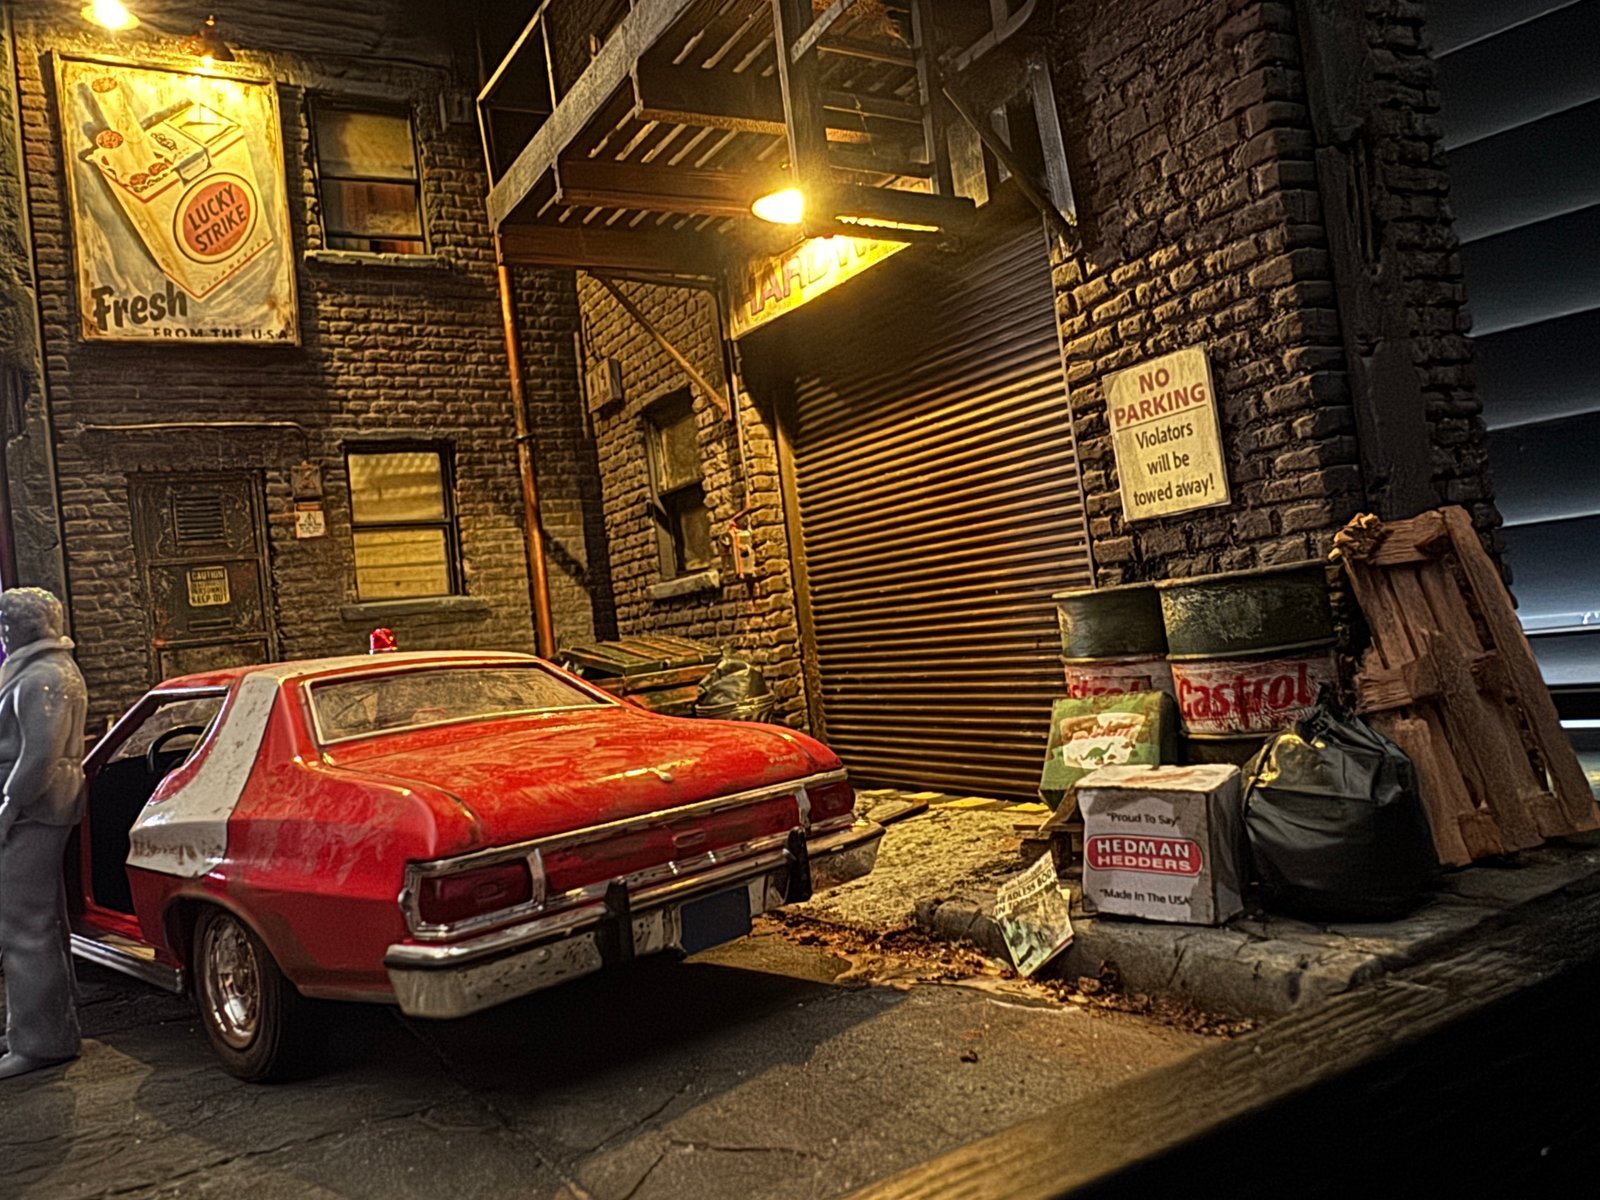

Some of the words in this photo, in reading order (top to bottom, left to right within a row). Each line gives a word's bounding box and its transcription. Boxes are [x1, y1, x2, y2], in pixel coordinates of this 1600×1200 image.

[188, 183, 237, 231] LUCKY
[194, 204, 247, 252] STRIKE
[91, 280, 187, 331] Fresh
[153, 327, 203, 338] FROM
[210, 328, 242, 339] THE
[1138, 368, 1170, 394] NO
[1114, 382, 1206, 427] PARKING
[1135, 422, 1194, 449] Violators
[1146, 453, 1172, 475] will
[1172, 451, 1190, 469] be
[1133, 482, 1173, 506] towed
[1176, 473, 1215, 497] away!
[191, 570, 224, 580] CAUTION
[1179, 663, 1313, 726] Castrol
[1144, 813, 1156, 823] To
[1096, 839, 1190, 858] HEDMAN
[1097, 855, 1192, 871] HEDDERS
[1134, 892, 1145, 901] In
[1147, 892, 1166, 904] The
